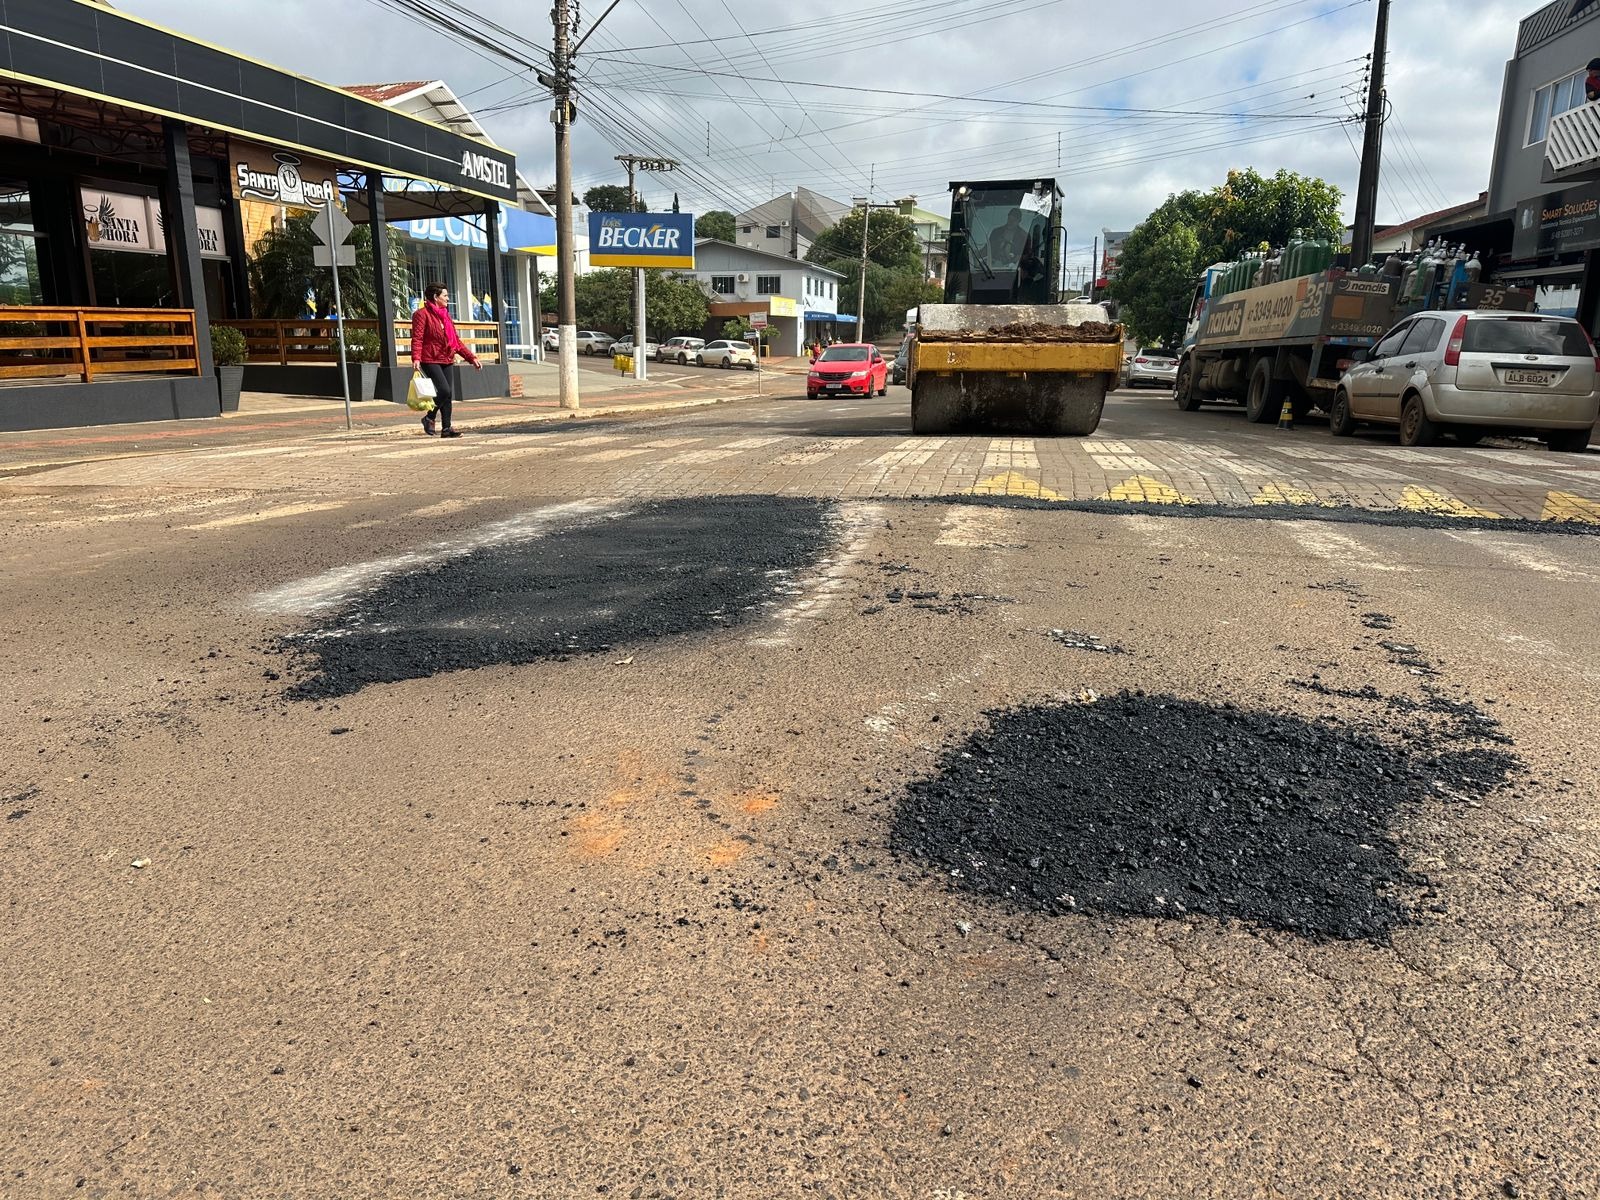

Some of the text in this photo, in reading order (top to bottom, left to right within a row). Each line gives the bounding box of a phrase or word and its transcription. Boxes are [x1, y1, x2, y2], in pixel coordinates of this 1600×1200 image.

[461, 150, 511, 189] AMSTEL
[237, 163, 279, 191] SANTA
[302, 180, 334, 200] HORA
[1541, 208, 1563, 221] SMART
[102, 216, 140, 233] SANTA
[106, 229, 139, 244] HORA
[598, 225, 680, 249] BECKER
[1303, 281, 1325, 308] 35
[1352, 282, 1387, 293] nandis
[1480, 289, 1506, 305] 35
[1206, 304, 1243, 334] nandis
[1300, 307, 1322, 318] anos
